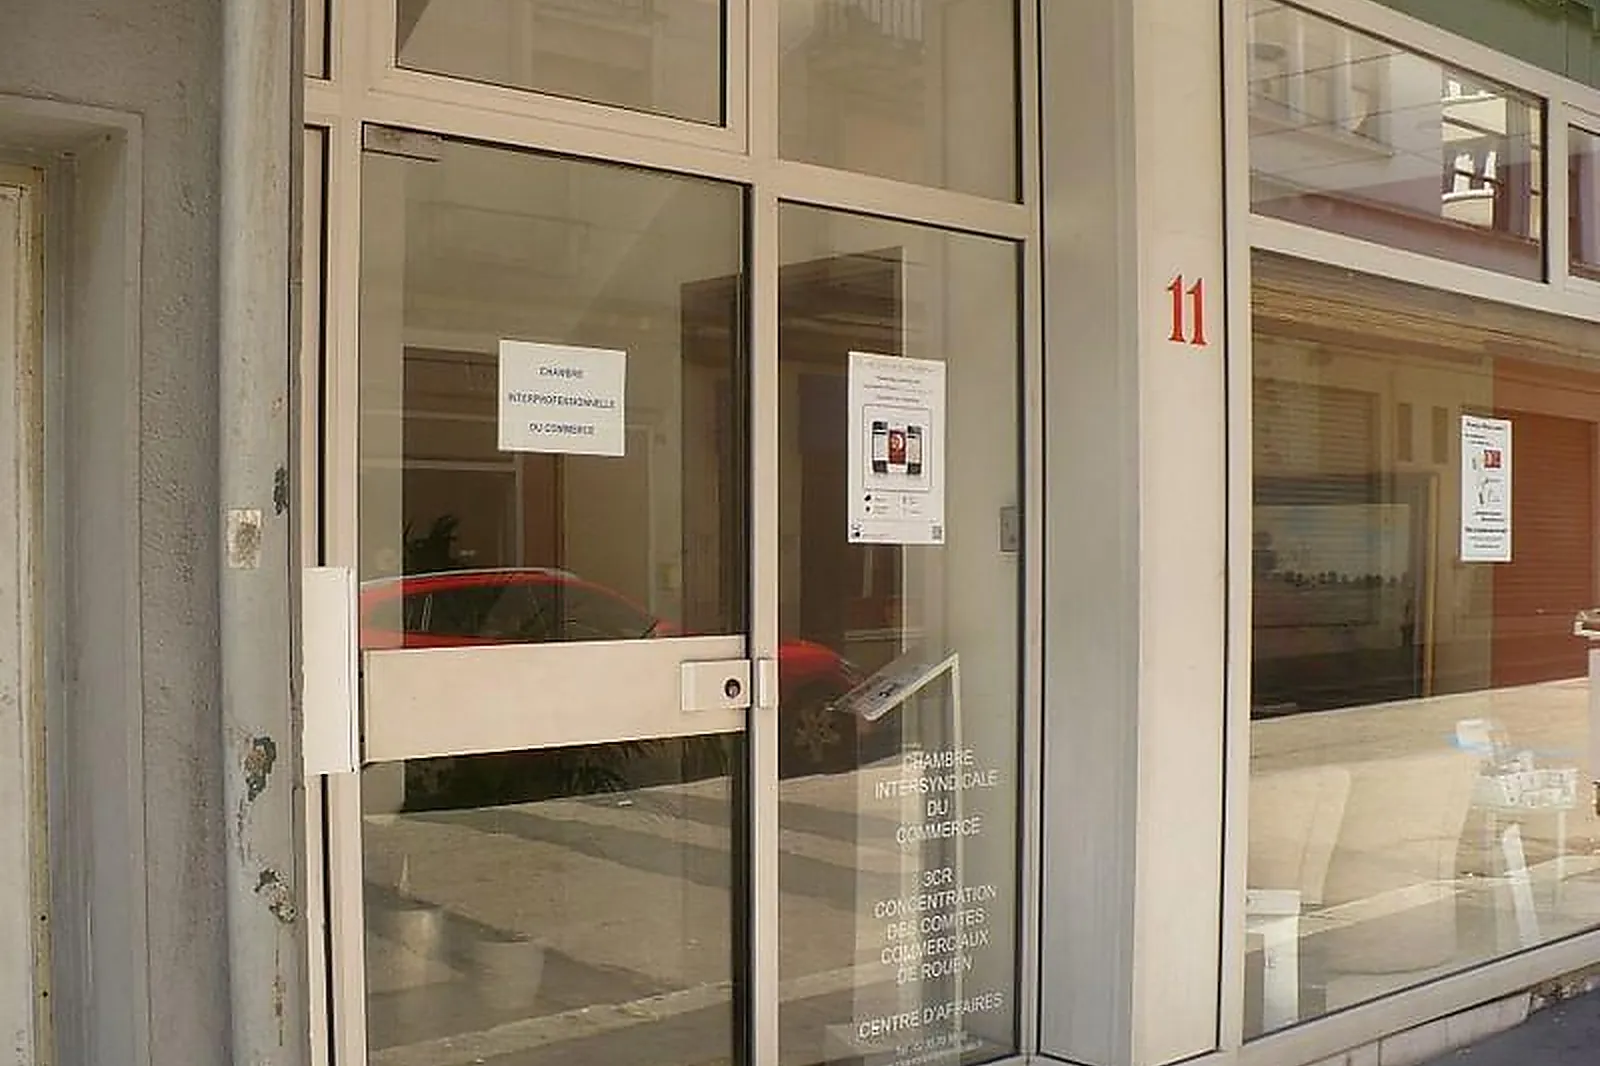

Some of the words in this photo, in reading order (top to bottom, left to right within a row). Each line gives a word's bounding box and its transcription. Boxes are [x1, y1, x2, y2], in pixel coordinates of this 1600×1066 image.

[1168, 274, 1207, 345] 11
[540, 366, 584, 379] CHAMBRE
[903, 749, 973, 769] CHAMBRE
[875, 769, 998, 799] INTERSYNDCALE
[927, 799, 949, 816] DU
[896, 816, 981, 844] COMMERCE
[874, 885, 998, 918] CONCENTRATION
[887, 919, 917, 940] DES
[921, 907, 985, 933] COMTES
[881, 929, 989, 964] COMMERCAUX
[897, 966, 918, 985] DE
[921, 955, 972, 978] ROUEN
[859, 1009, 919, 1038] CENTRE
[923, 992, 1004, 1024] D'AFFAIRES
